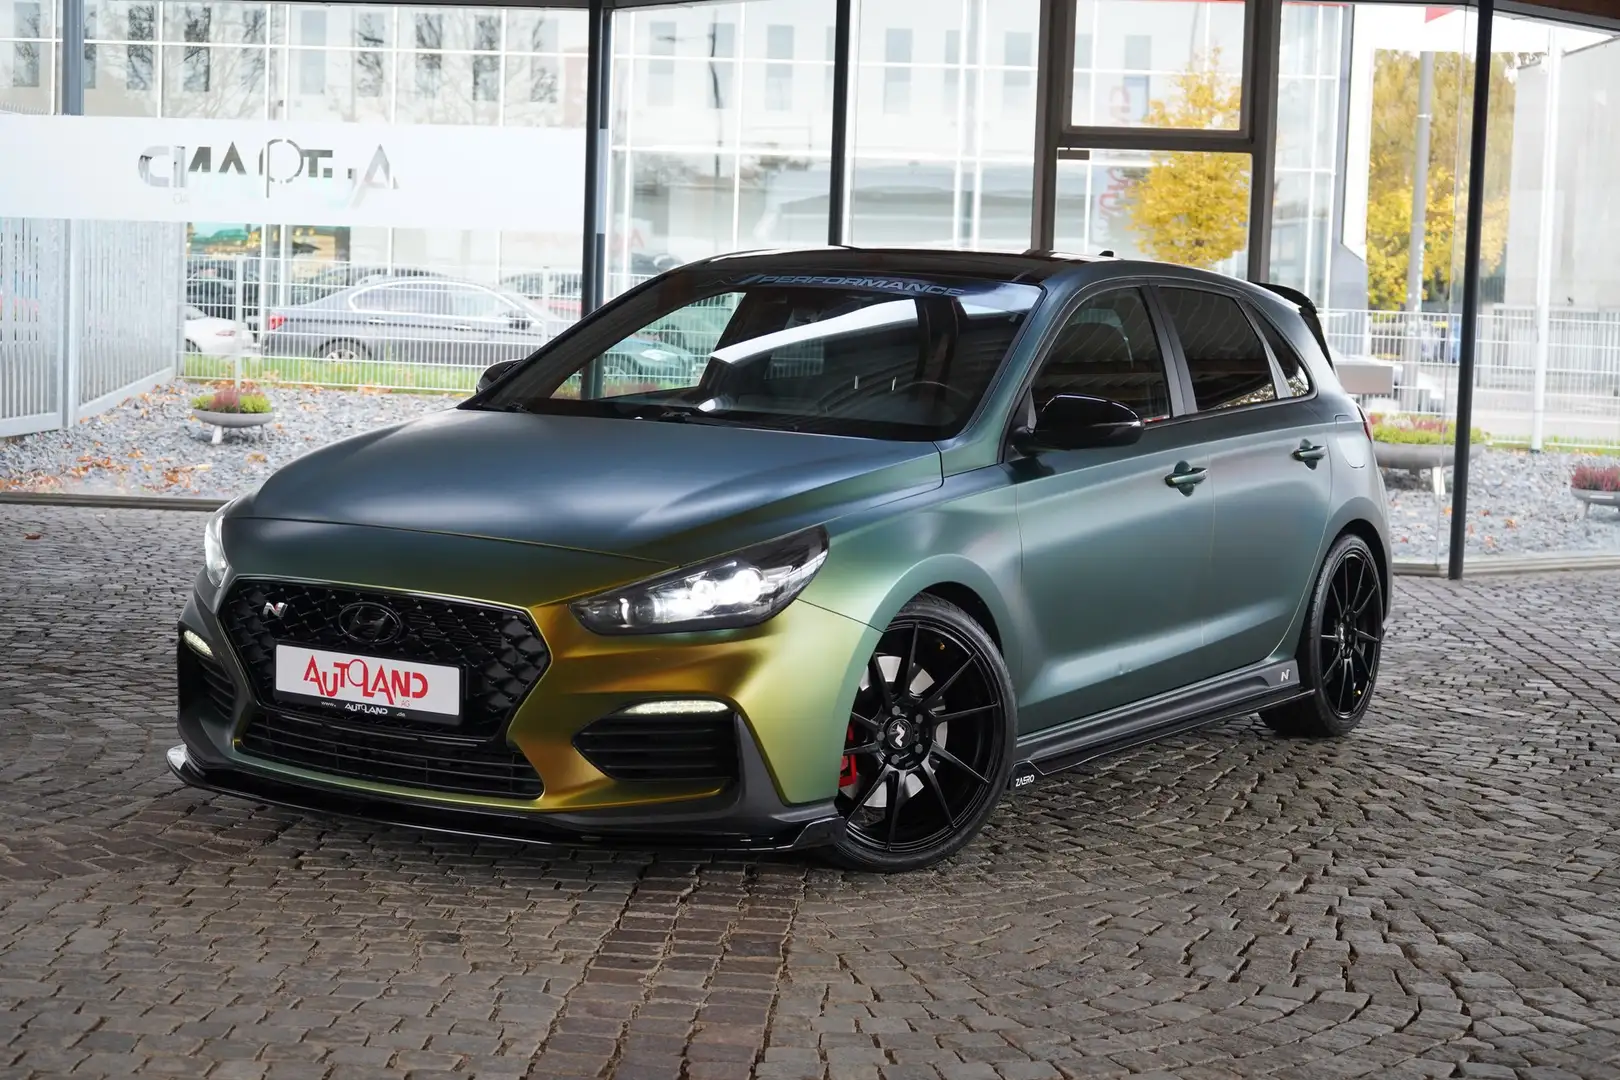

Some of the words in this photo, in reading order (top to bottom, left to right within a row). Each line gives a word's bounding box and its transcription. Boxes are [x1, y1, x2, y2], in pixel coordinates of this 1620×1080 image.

[757, 275, 966, 297] PERFORMANCE
[303, 655, 429, 705] AUTOLAND
[1280, 669, 1290, 682] N
[344, 702, 388, 715] AUTOLAND
